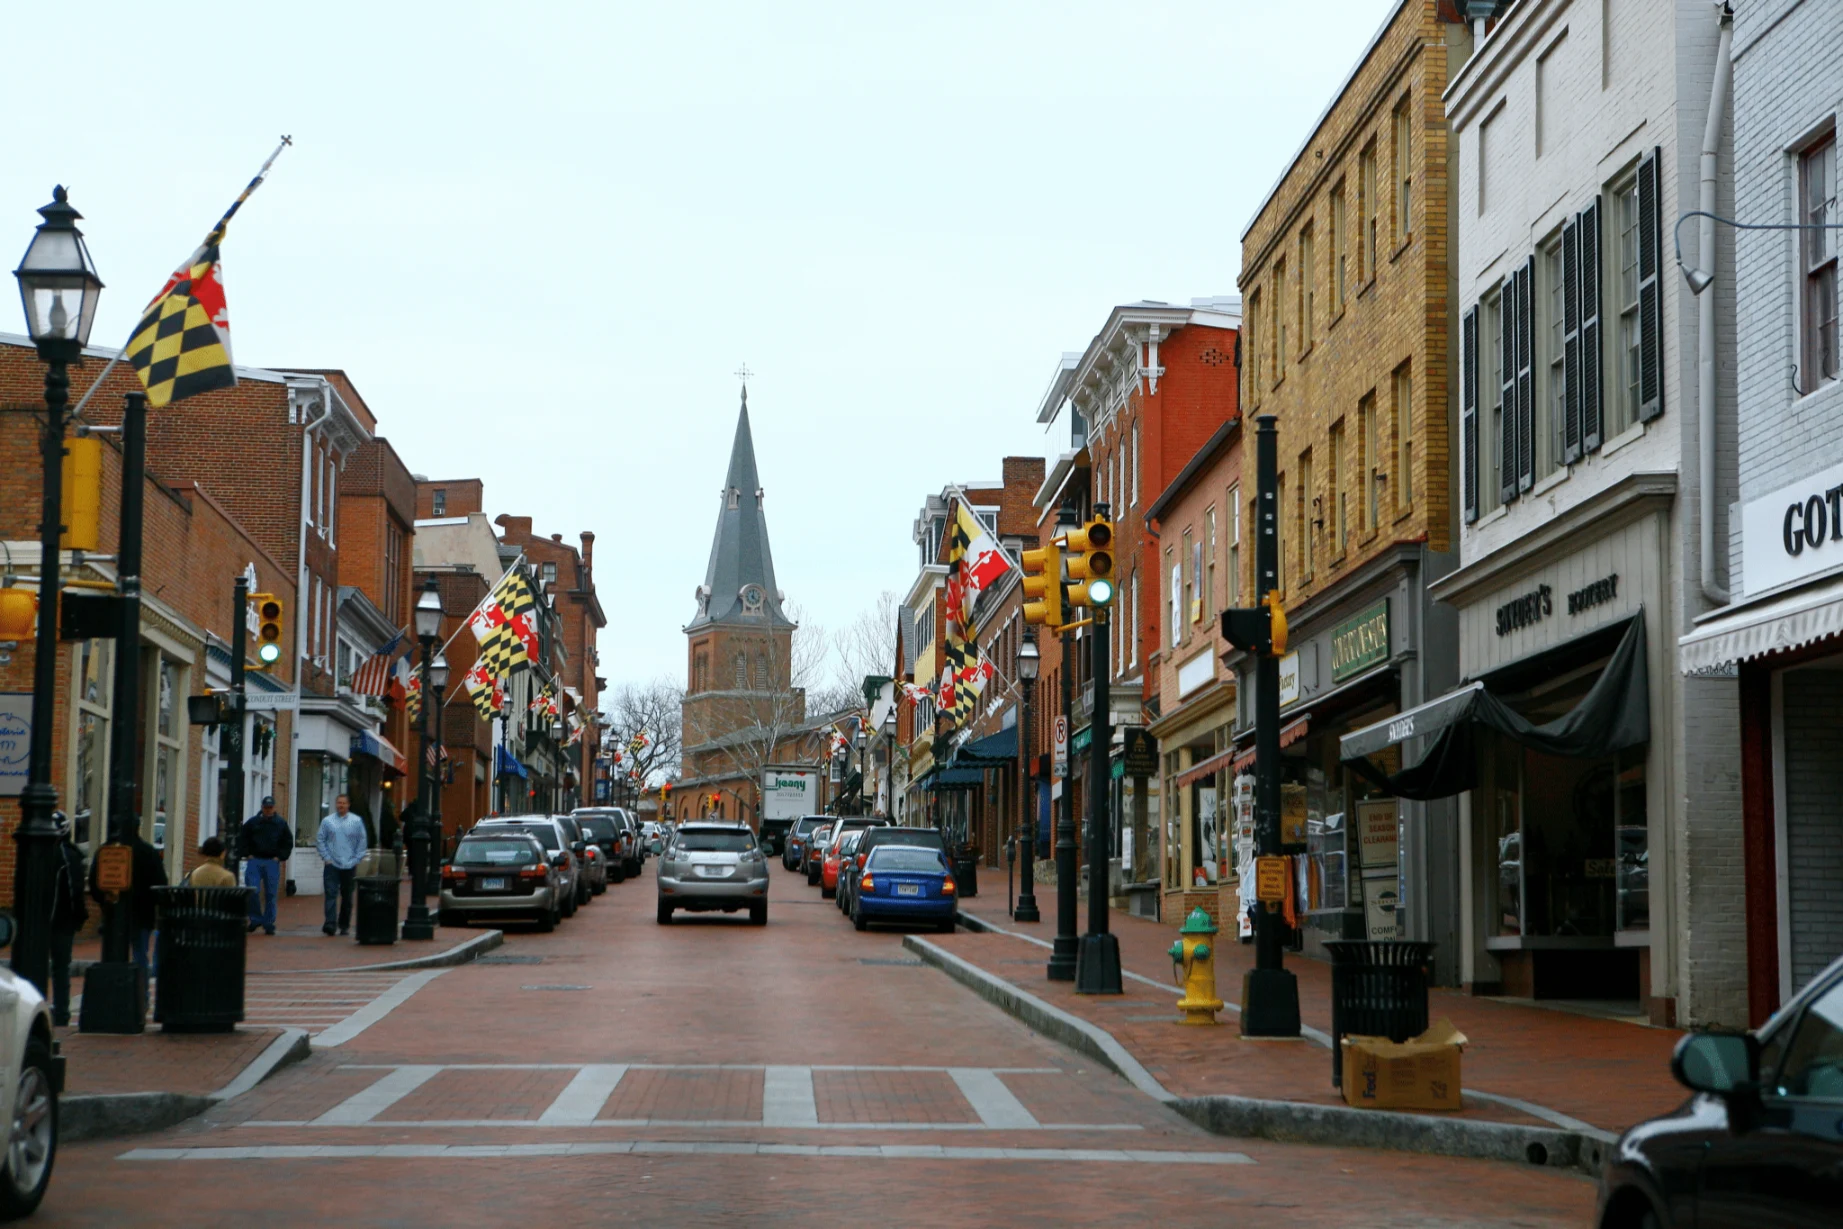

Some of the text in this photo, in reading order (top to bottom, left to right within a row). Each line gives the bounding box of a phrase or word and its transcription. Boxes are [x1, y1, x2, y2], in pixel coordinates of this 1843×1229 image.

[1783, 483, 1843, 557] GOT
[247, 694, 297, 704] CONDUIT STREET
[1369, 824, 1396, 833] SEASON
